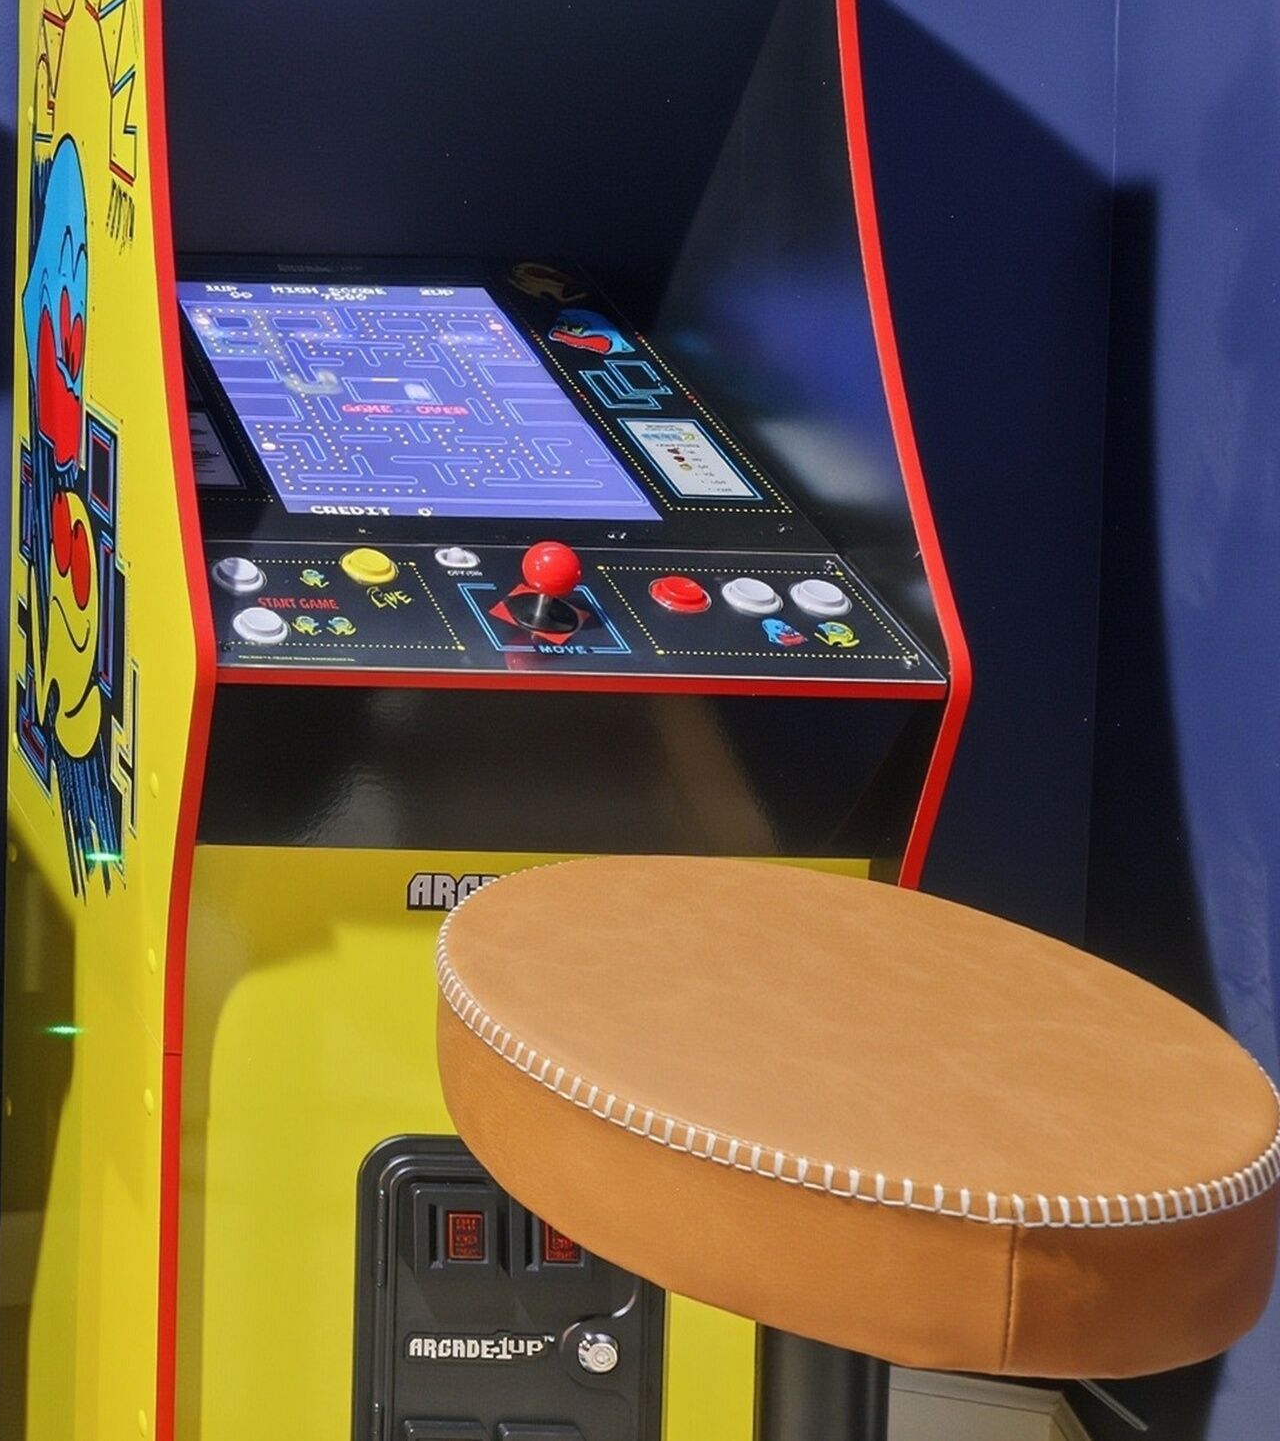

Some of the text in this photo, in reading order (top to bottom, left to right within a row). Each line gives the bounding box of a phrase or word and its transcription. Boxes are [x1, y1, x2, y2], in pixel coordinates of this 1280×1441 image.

[415, 405, 470, 416] OVER
[310, 505, 391, 516] CREDIT
[257, 596, 339, 610] START GAME
[538, 645, 588, 655] MOVE
